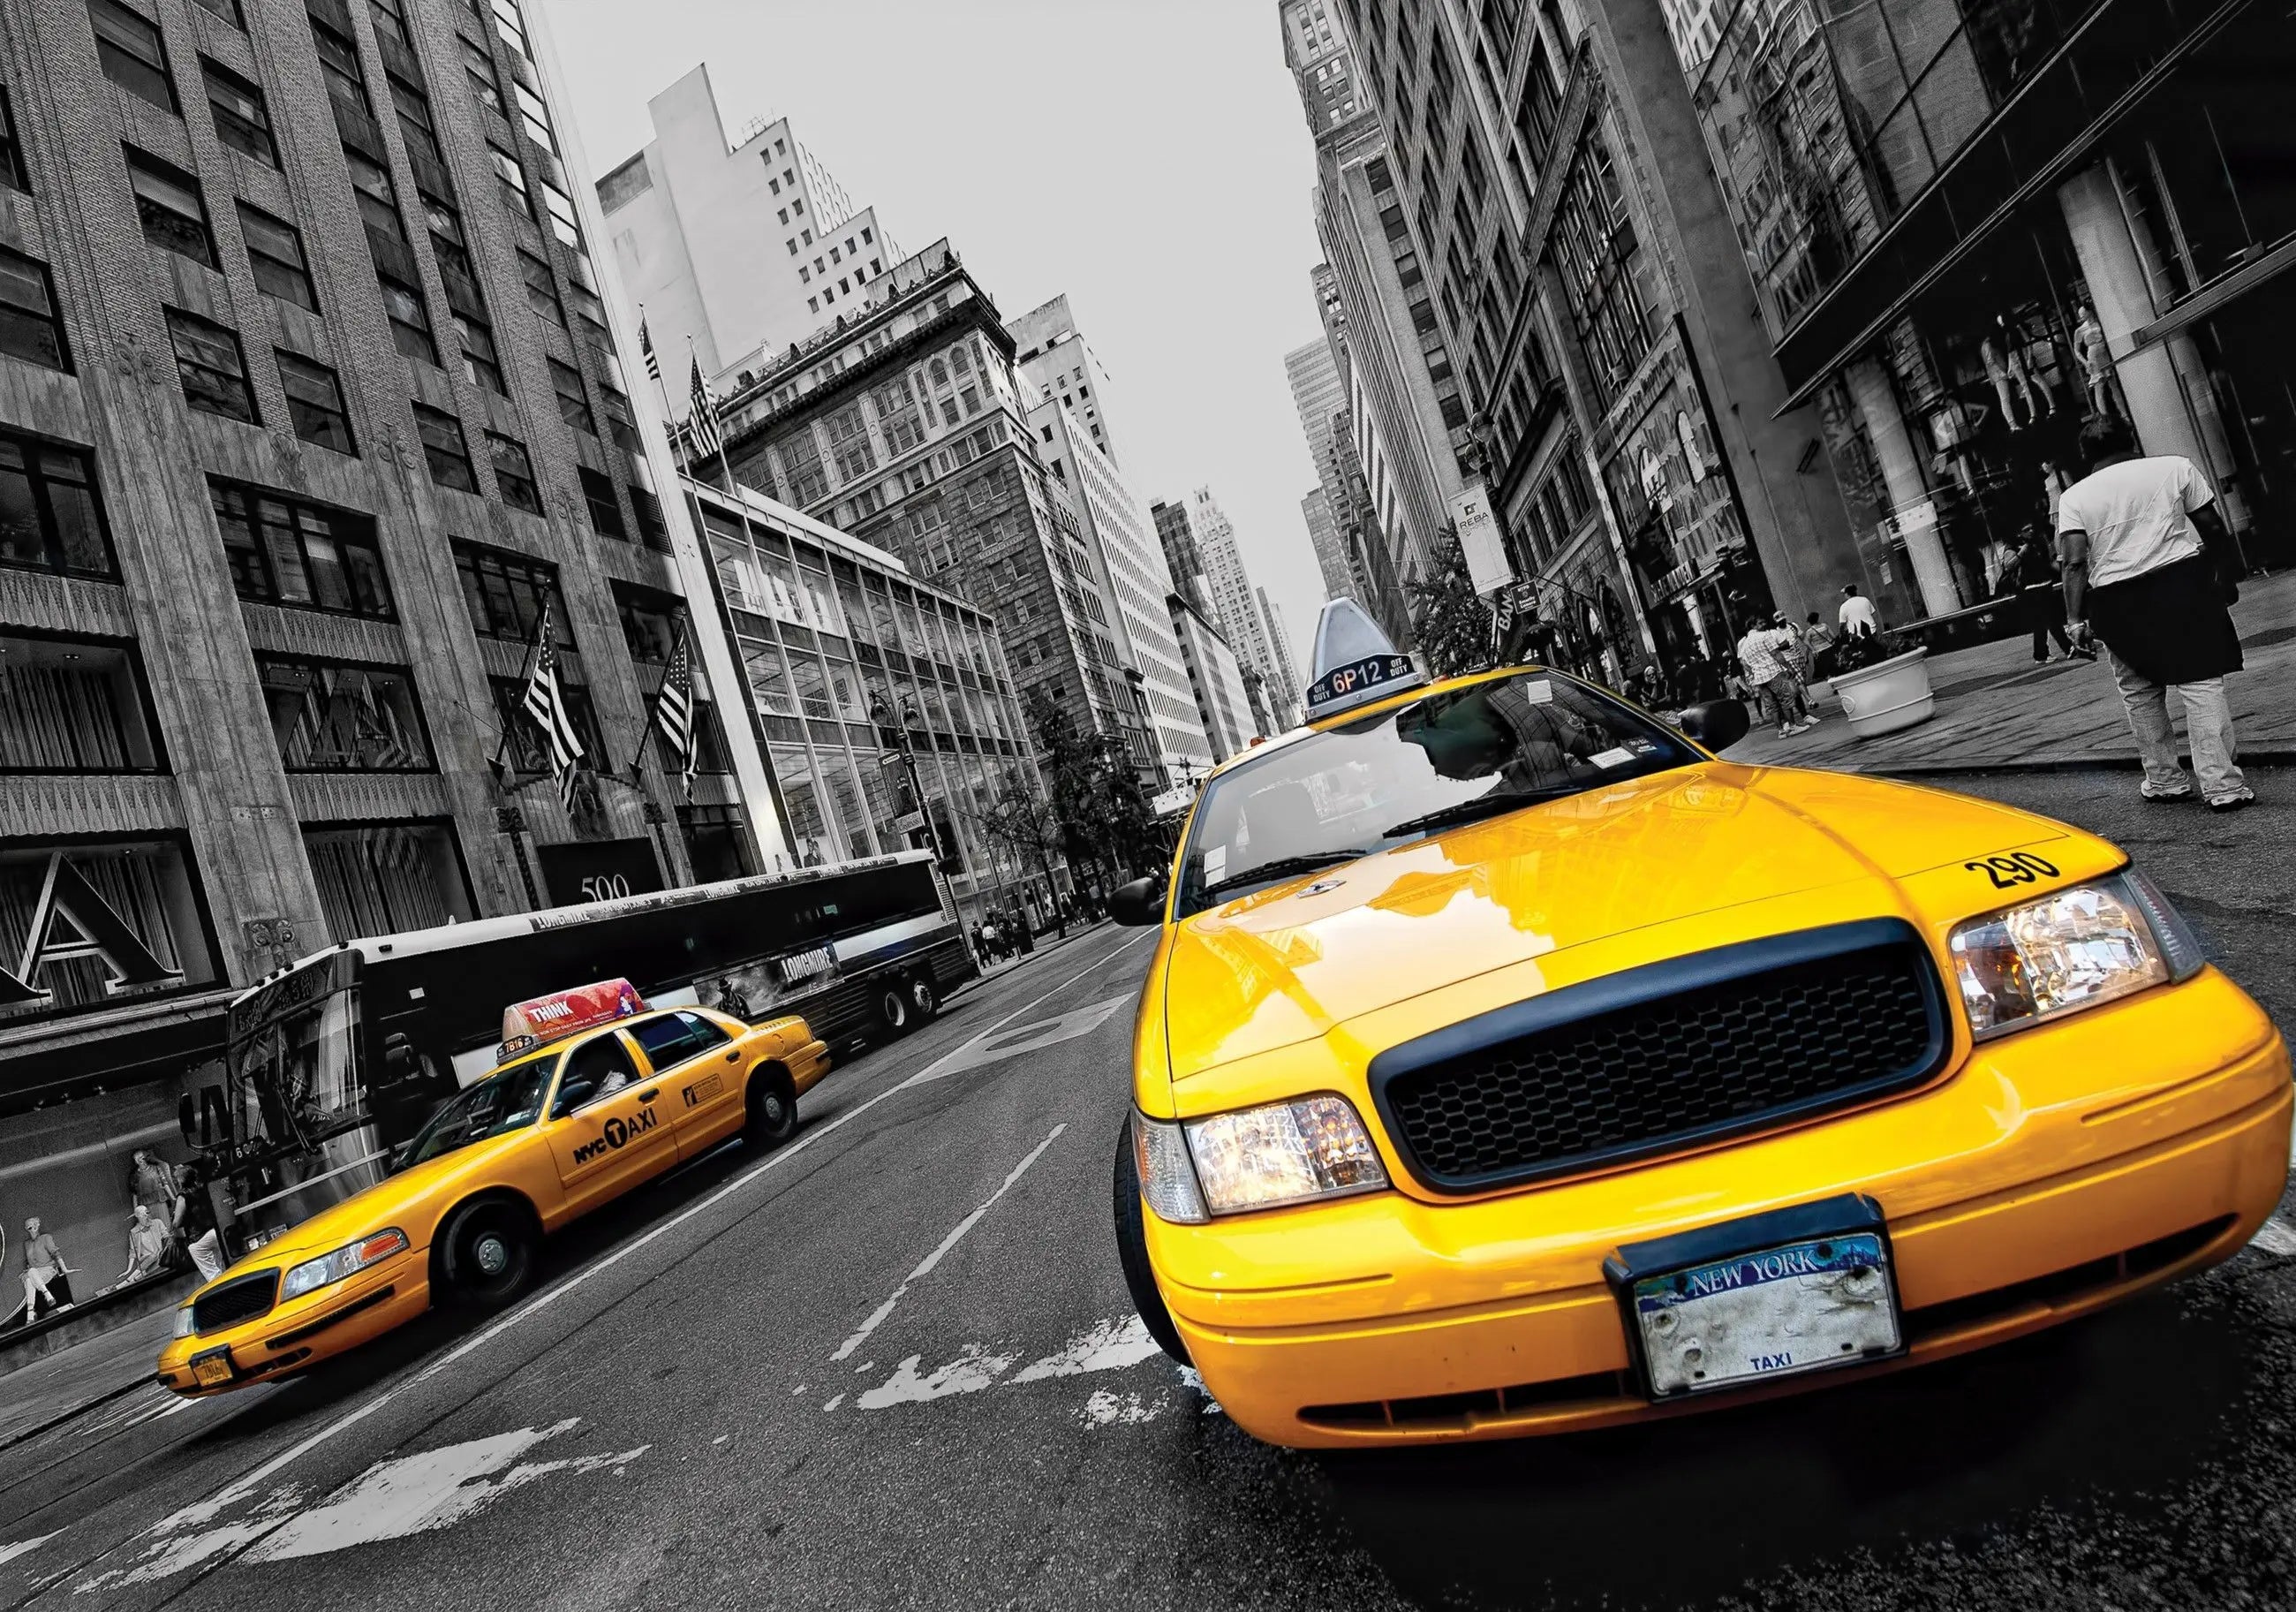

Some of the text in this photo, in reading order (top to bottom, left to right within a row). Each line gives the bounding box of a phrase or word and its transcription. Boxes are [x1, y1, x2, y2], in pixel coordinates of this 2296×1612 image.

[1460, 512, 1489, 530] REBA
[1498, 588, 1514, 631] BAN
[1390, 657, 1402, 668] OFF
[1390, 664, 1408, 677] DUTY
[1314, 684, 1325, 693] OFF
[1333, 661, 1382, 693] 6P12
[1313, 690, 1330, 702] DUTY
[1964, 852, 2060, 889] 290
[582, 874, 630, 902] 500
[0, 851, 185, 1018] A
[781, 947, 834, 982] LONGMIRE
[529, 1001, 573, 1023] THINK
[504, 1037, 524, 1053] 7B16
[573, 1108, 658, 1164] NYC TAXI
[1691, 1250, 1819, 1297] NEW YORK
[1751, 1352, 1792, 1370] TAXI
